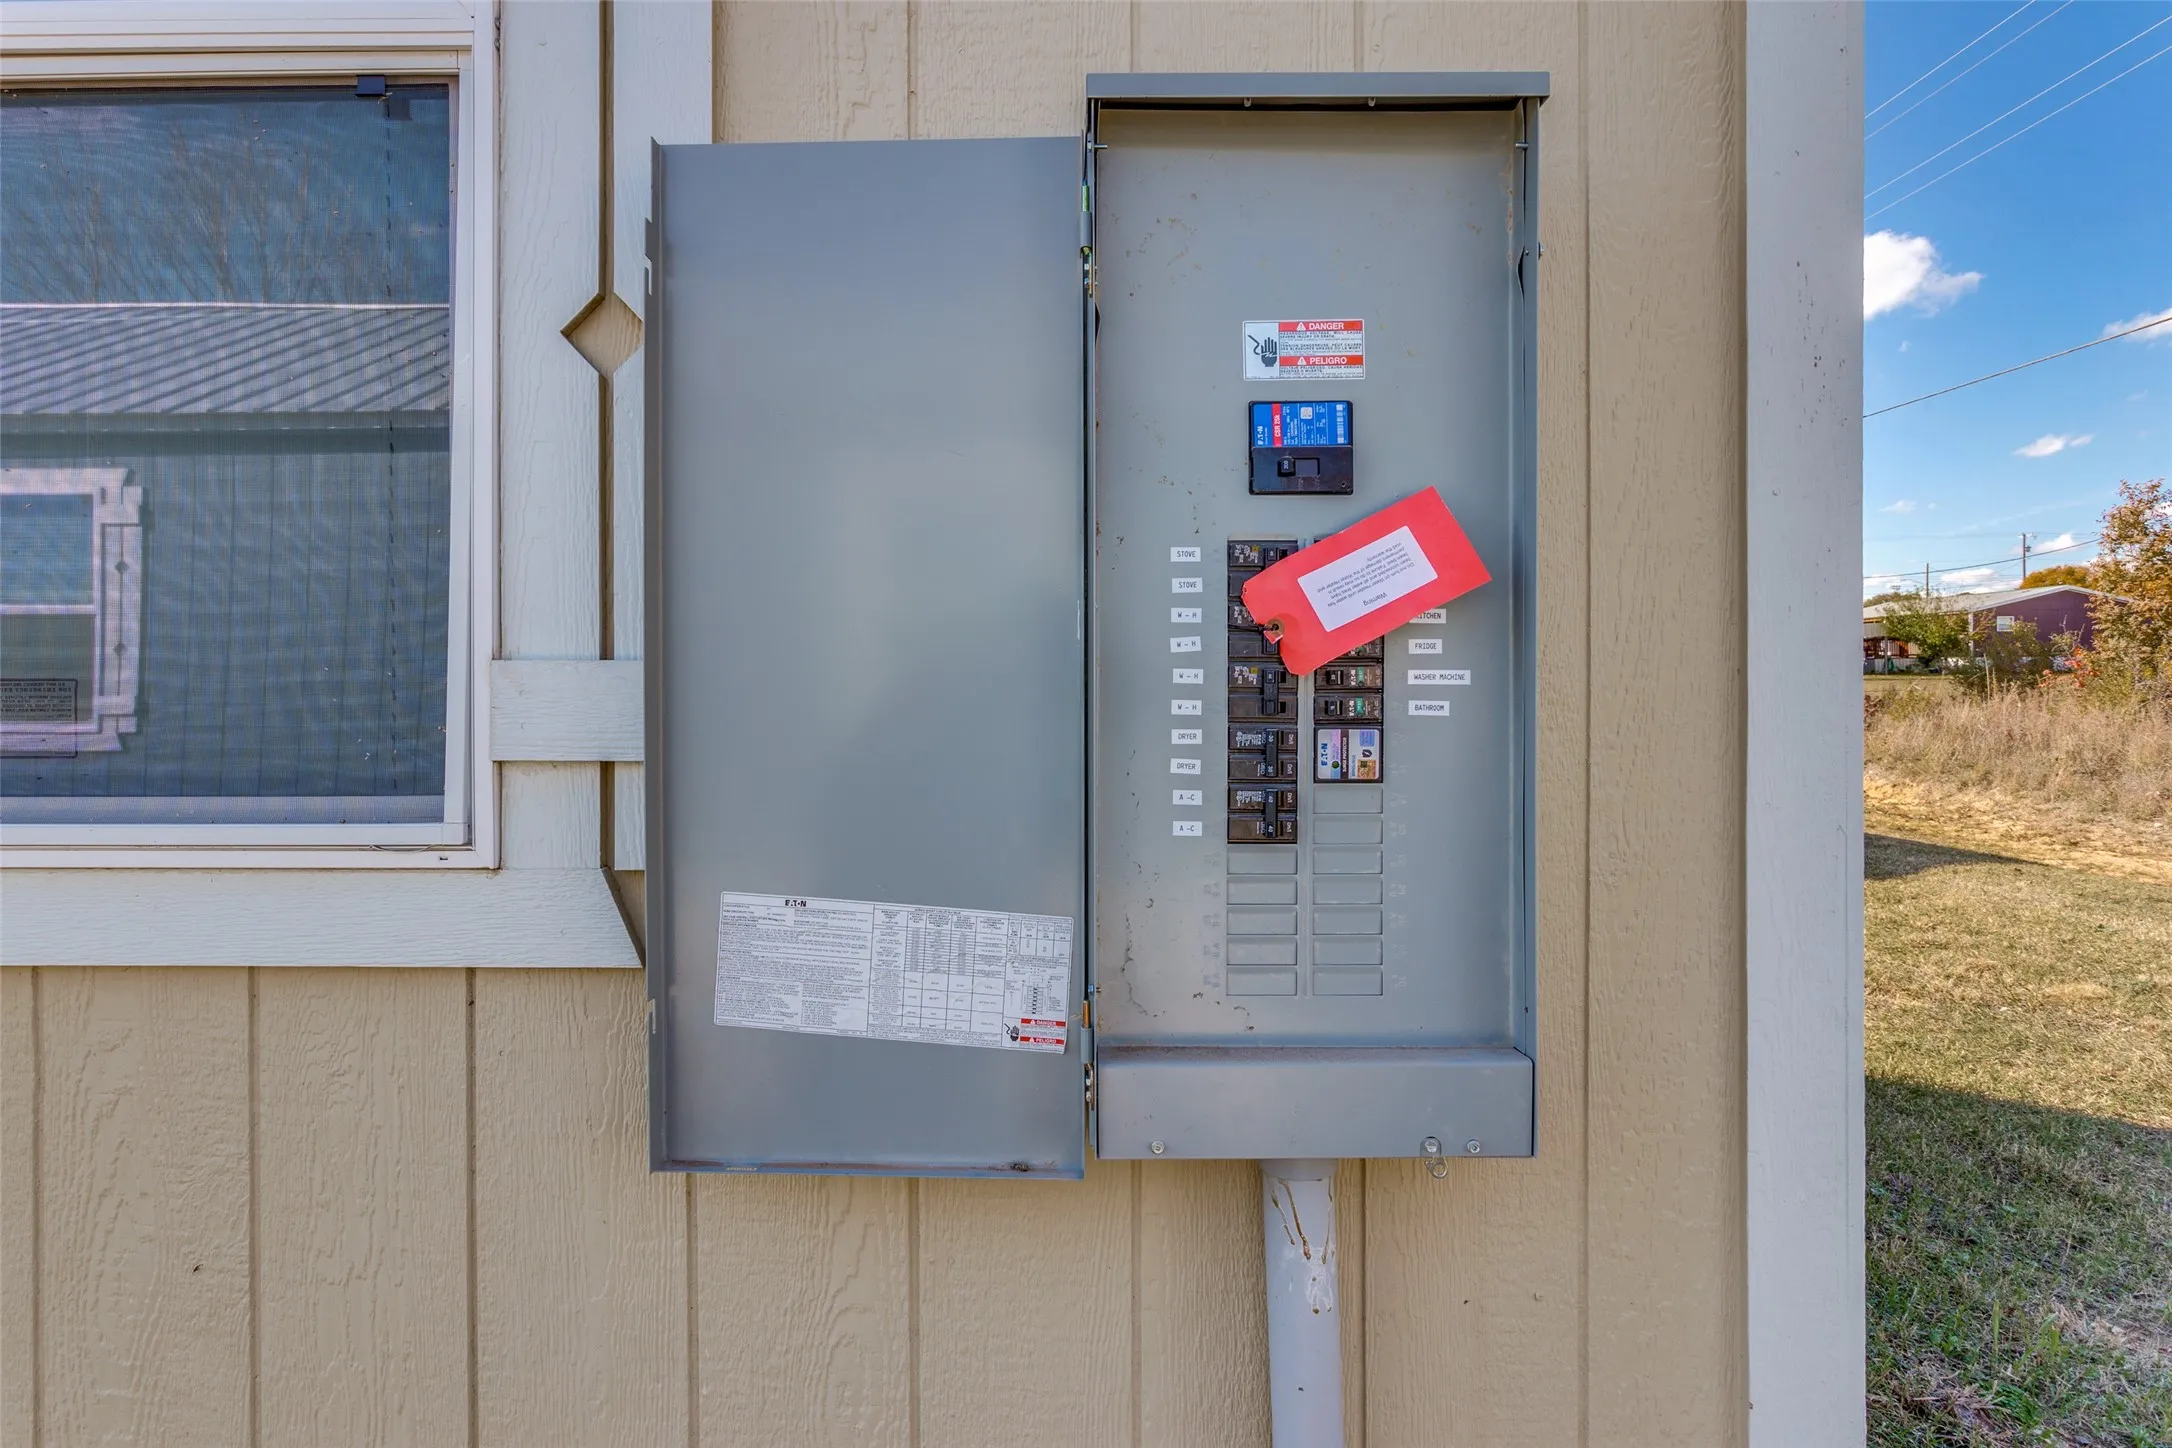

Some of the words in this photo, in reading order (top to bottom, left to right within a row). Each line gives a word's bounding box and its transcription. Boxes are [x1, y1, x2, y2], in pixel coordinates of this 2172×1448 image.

[1364, 557, 1382, 569] damage
[1398, 556, 1411, 565] been
[1370, 562, 1386, 573] Failure
[1377, 562, 1399, 576] connected
[1339, 572, 1352, 582] Water
[1370, 576, 1384, 586] Water
[1325, 578, 1340, 589] Heater
[1331, 583, 1344, 592] result
[1351, 580, 1363, 589] water
[1356, 582, 1371, 593] Heater
[1340, 586, 1351, 594] lines
[1330, 591, 1341, 600] have
[1335, 594, 1347, 604] water
[1362, 590, 1387, 607] Warning
